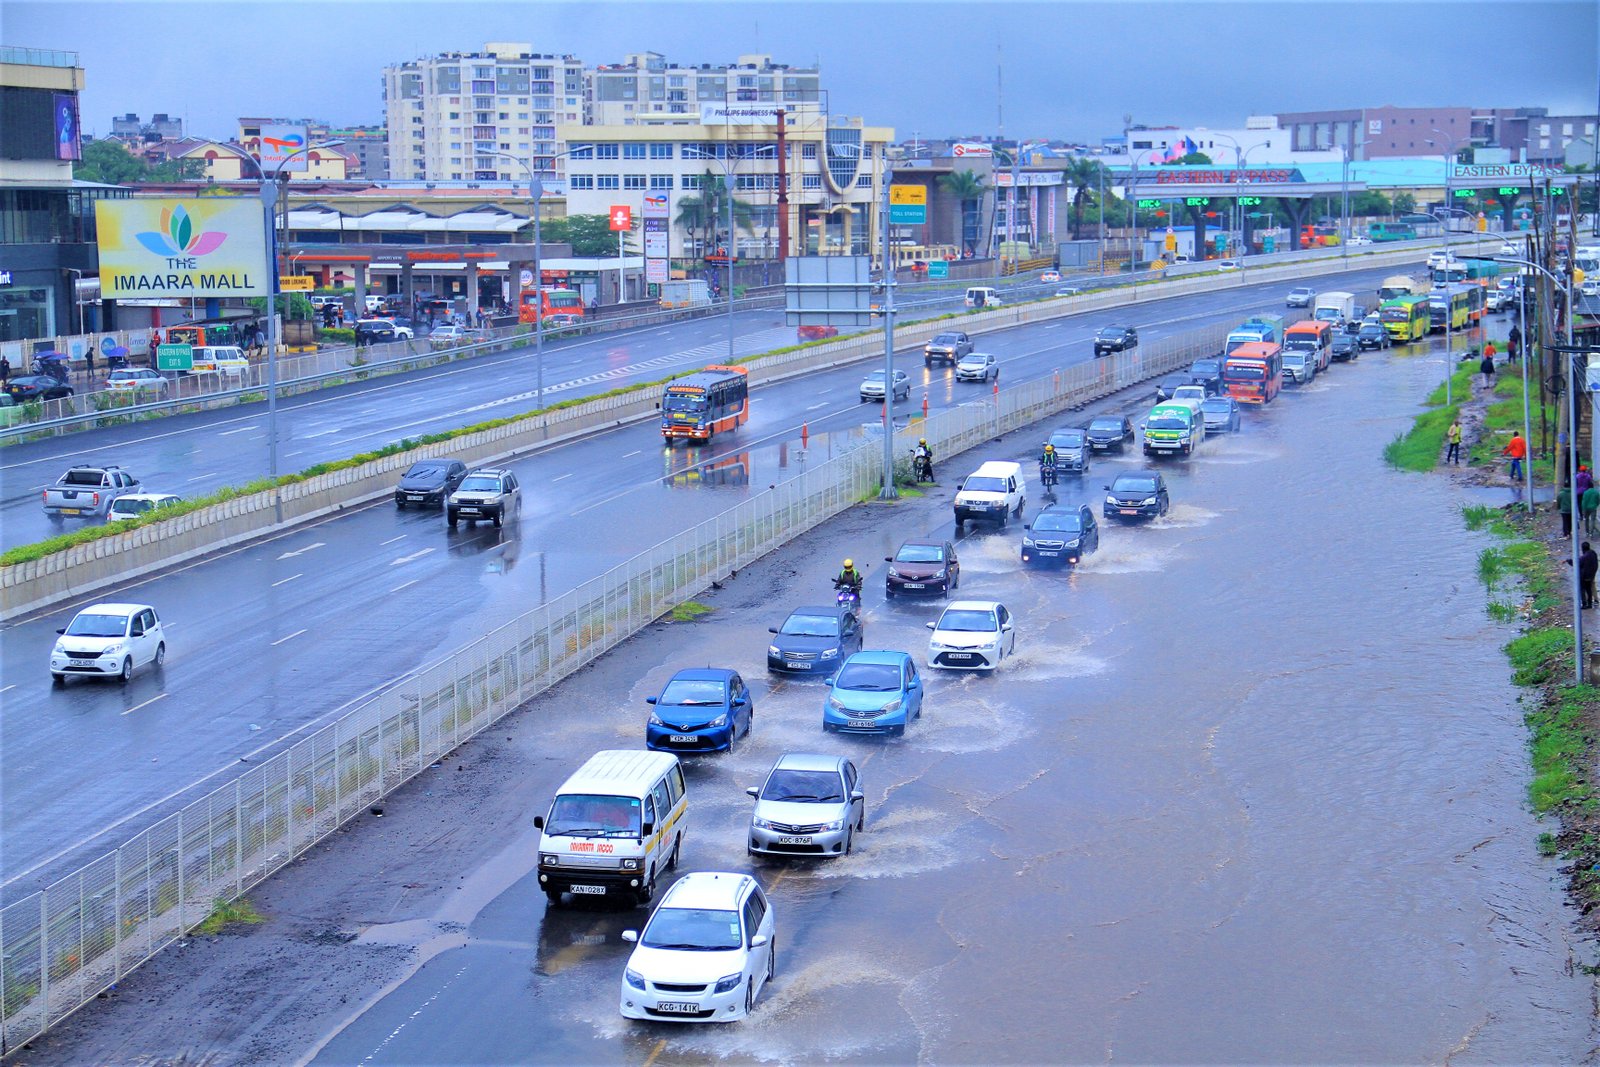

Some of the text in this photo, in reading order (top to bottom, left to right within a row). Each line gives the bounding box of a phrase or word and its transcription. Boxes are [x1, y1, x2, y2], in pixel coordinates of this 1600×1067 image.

[1455, 163, 1566, 177] EASTERN BYPASS
[1156, 170, 1224, 184] EASTERN
[1138, 200, 1155, 208] MTC
[1187, 198, 1202, 206] ETC
[1239, 198, 1254, 206] ETC
[166, 257, 198, 270] THE
[114, 273, 255, 290] IMAARA MALL
[159, 348, 175, 356] EASTERN
[571, 885, 605, 894] KAN 028X
